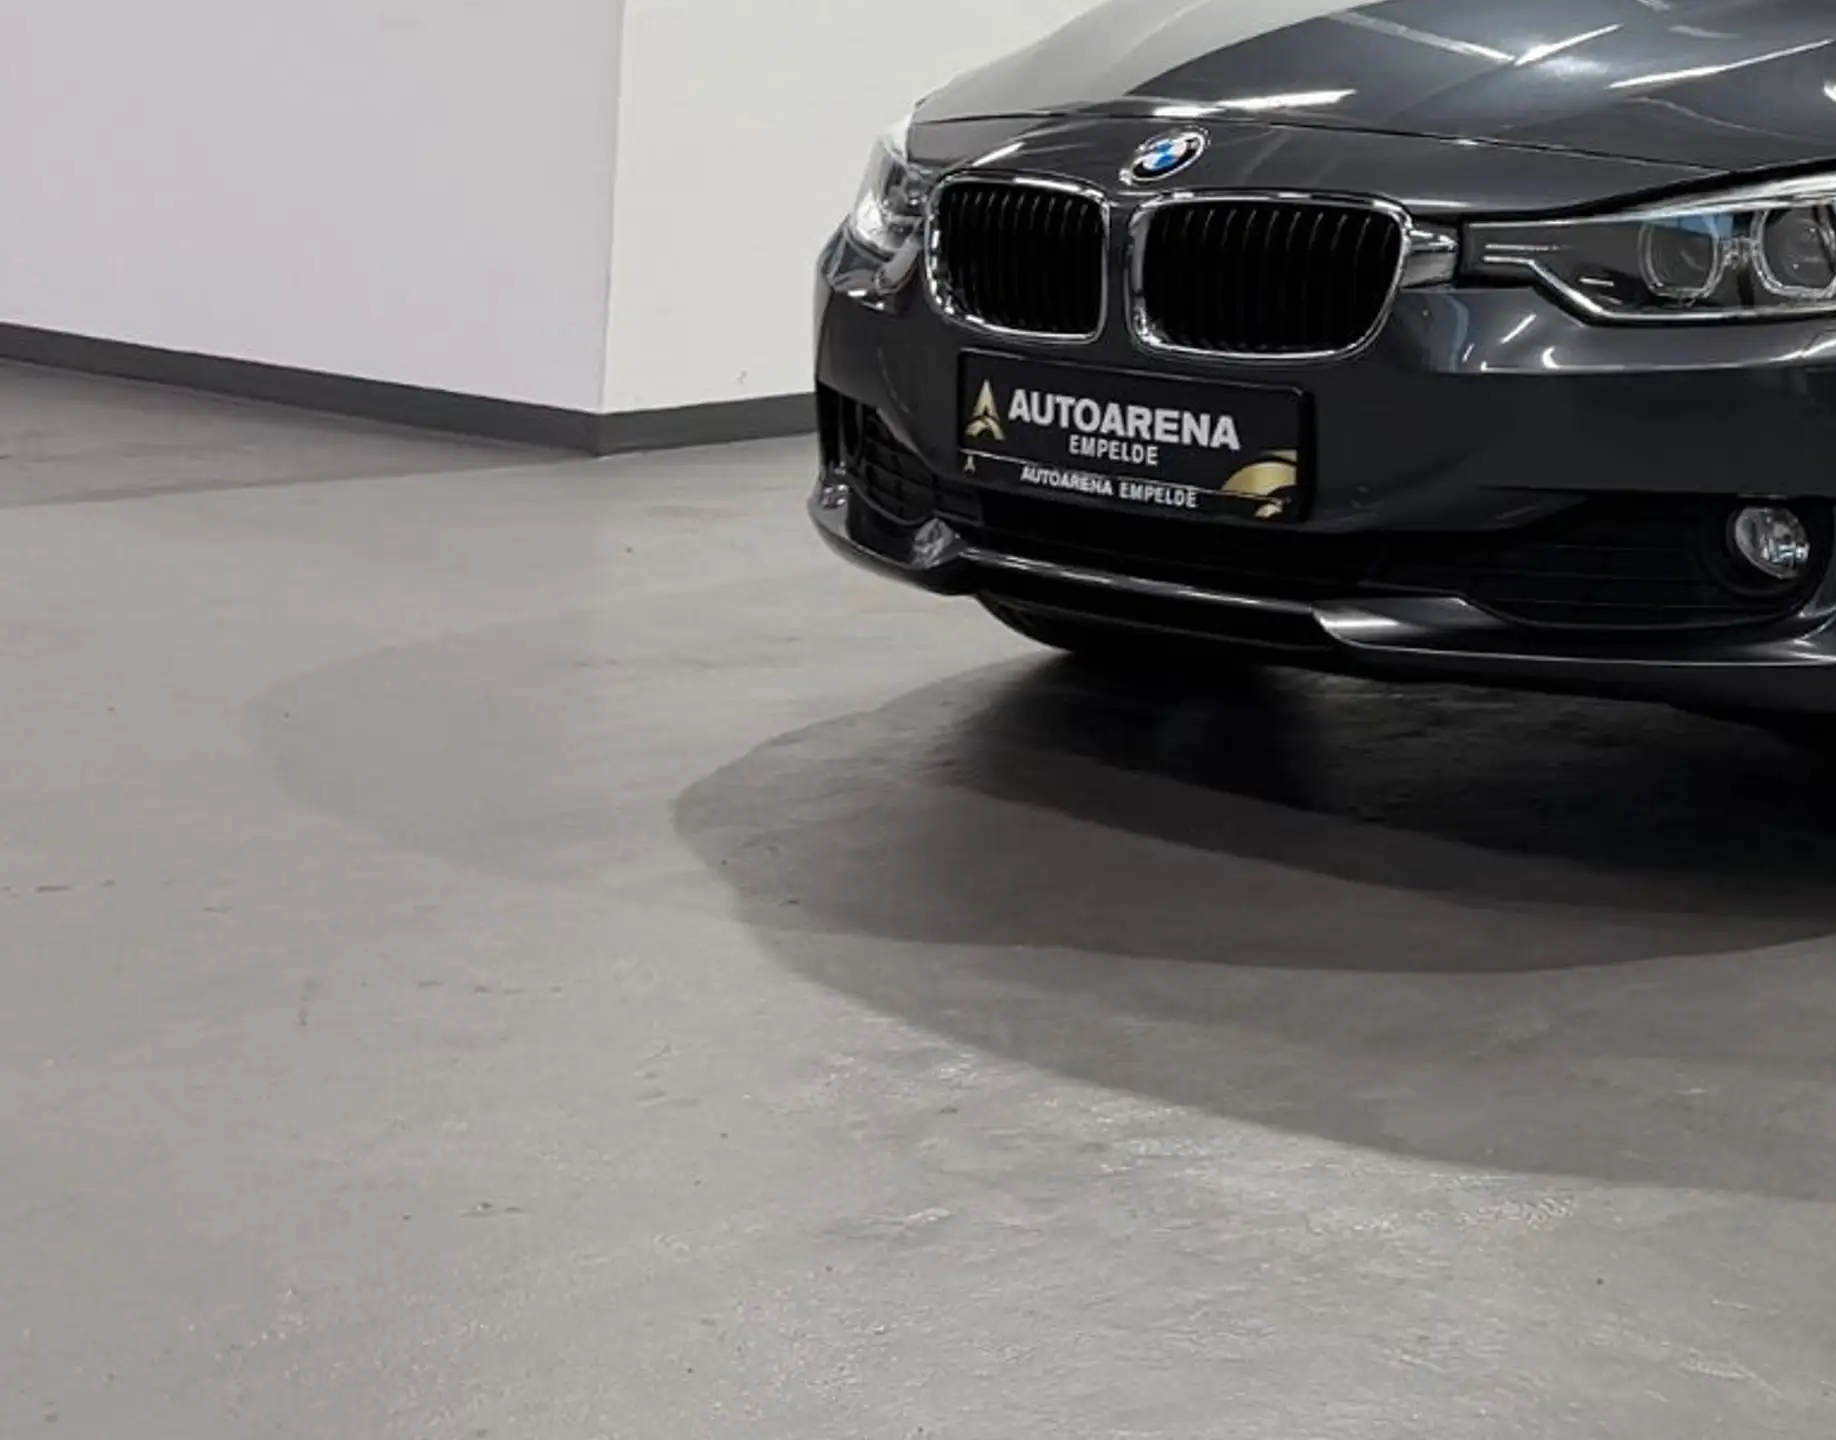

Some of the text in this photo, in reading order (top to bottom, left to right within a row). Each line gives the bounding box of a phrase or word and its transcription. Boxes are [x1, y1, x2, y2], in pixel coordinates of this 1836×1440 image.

[1008, 388, 1241, 451] AUTOARENA
[1069, 434, 1159, 466] EMPELDE
[1020, 466, 1197, 508] AUTOARENA EMPELDE
